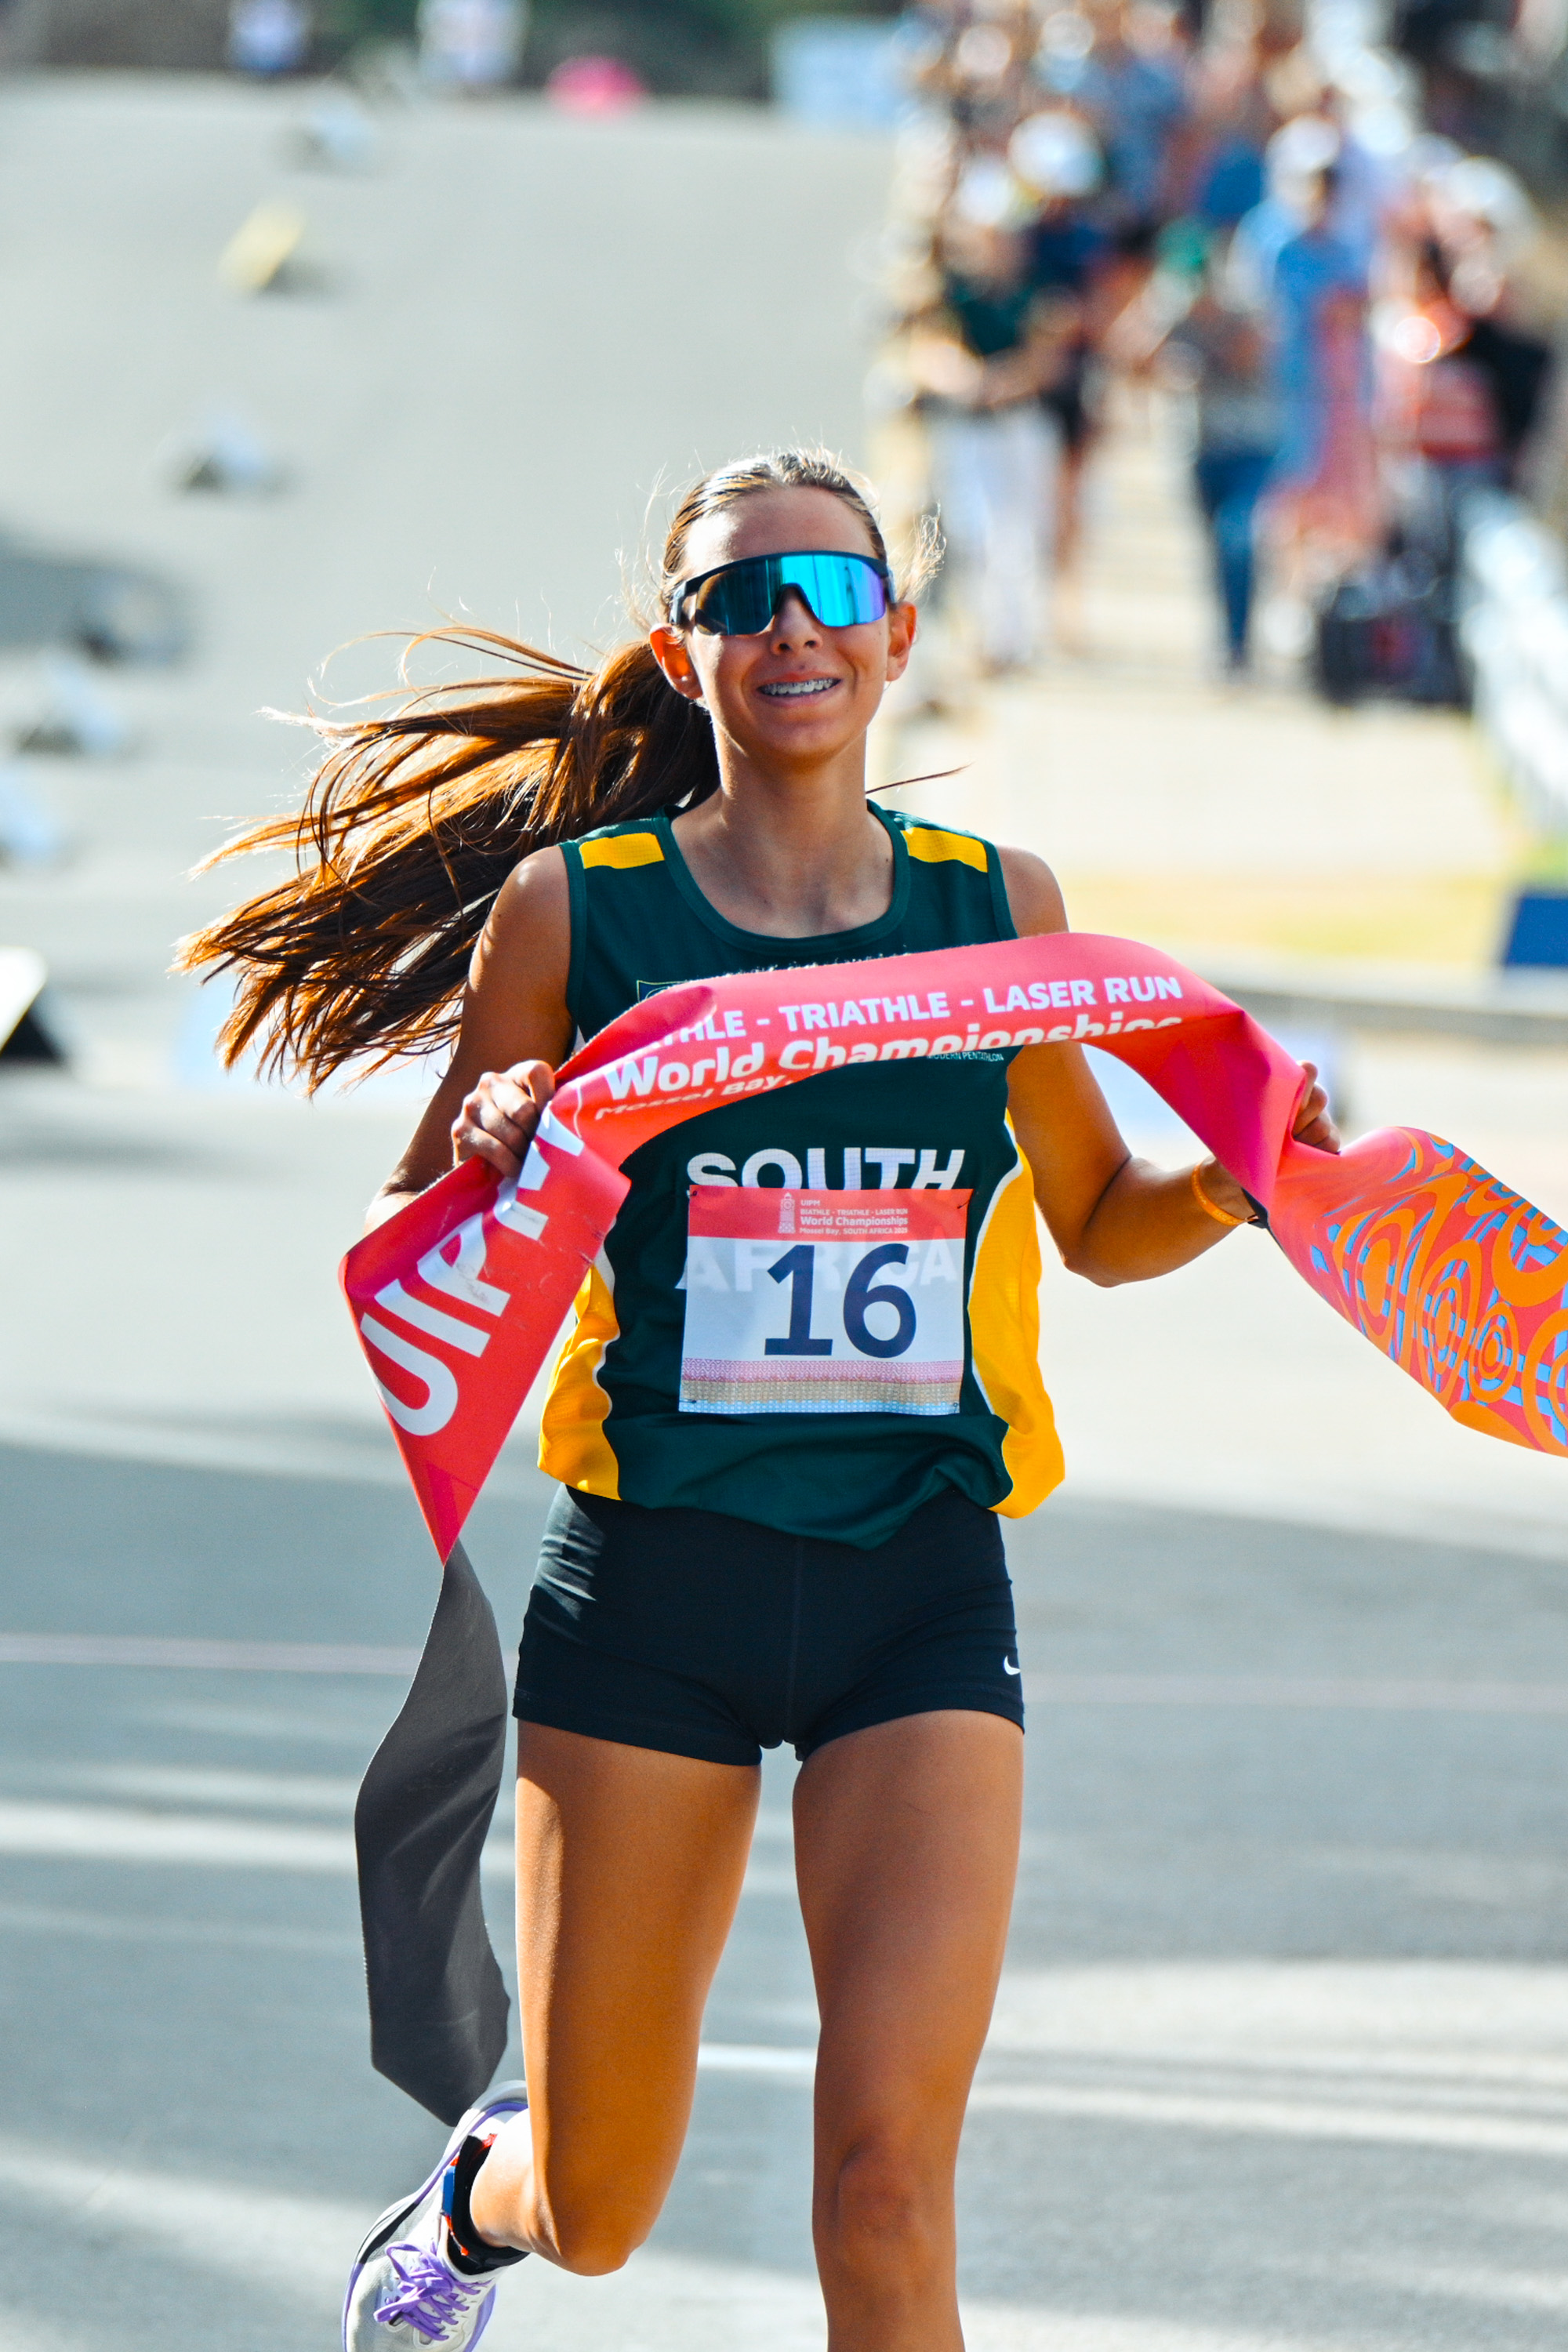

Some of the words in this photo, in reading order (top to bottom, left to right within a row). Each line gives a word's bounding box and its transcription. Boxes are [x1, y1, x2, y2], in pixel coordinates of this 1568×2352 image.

[779, 993, 950, 1033] TRIATHLE
[983, 980, 1096, 1013] LASER
[1104, 977, 1182, 1004] RUN
[604, 1042, 764, 1101] World
[963, 1051, 1004, 1062] PENTATHLON
[595, 1088, 714, 1120] Mossel
[687, 1148, 965, 1190] SOUTH
[800, 1216, 833, 1225] World
[836, 1216, 908, 1228] Championships
[764, 1243, 916, 1358] 16
